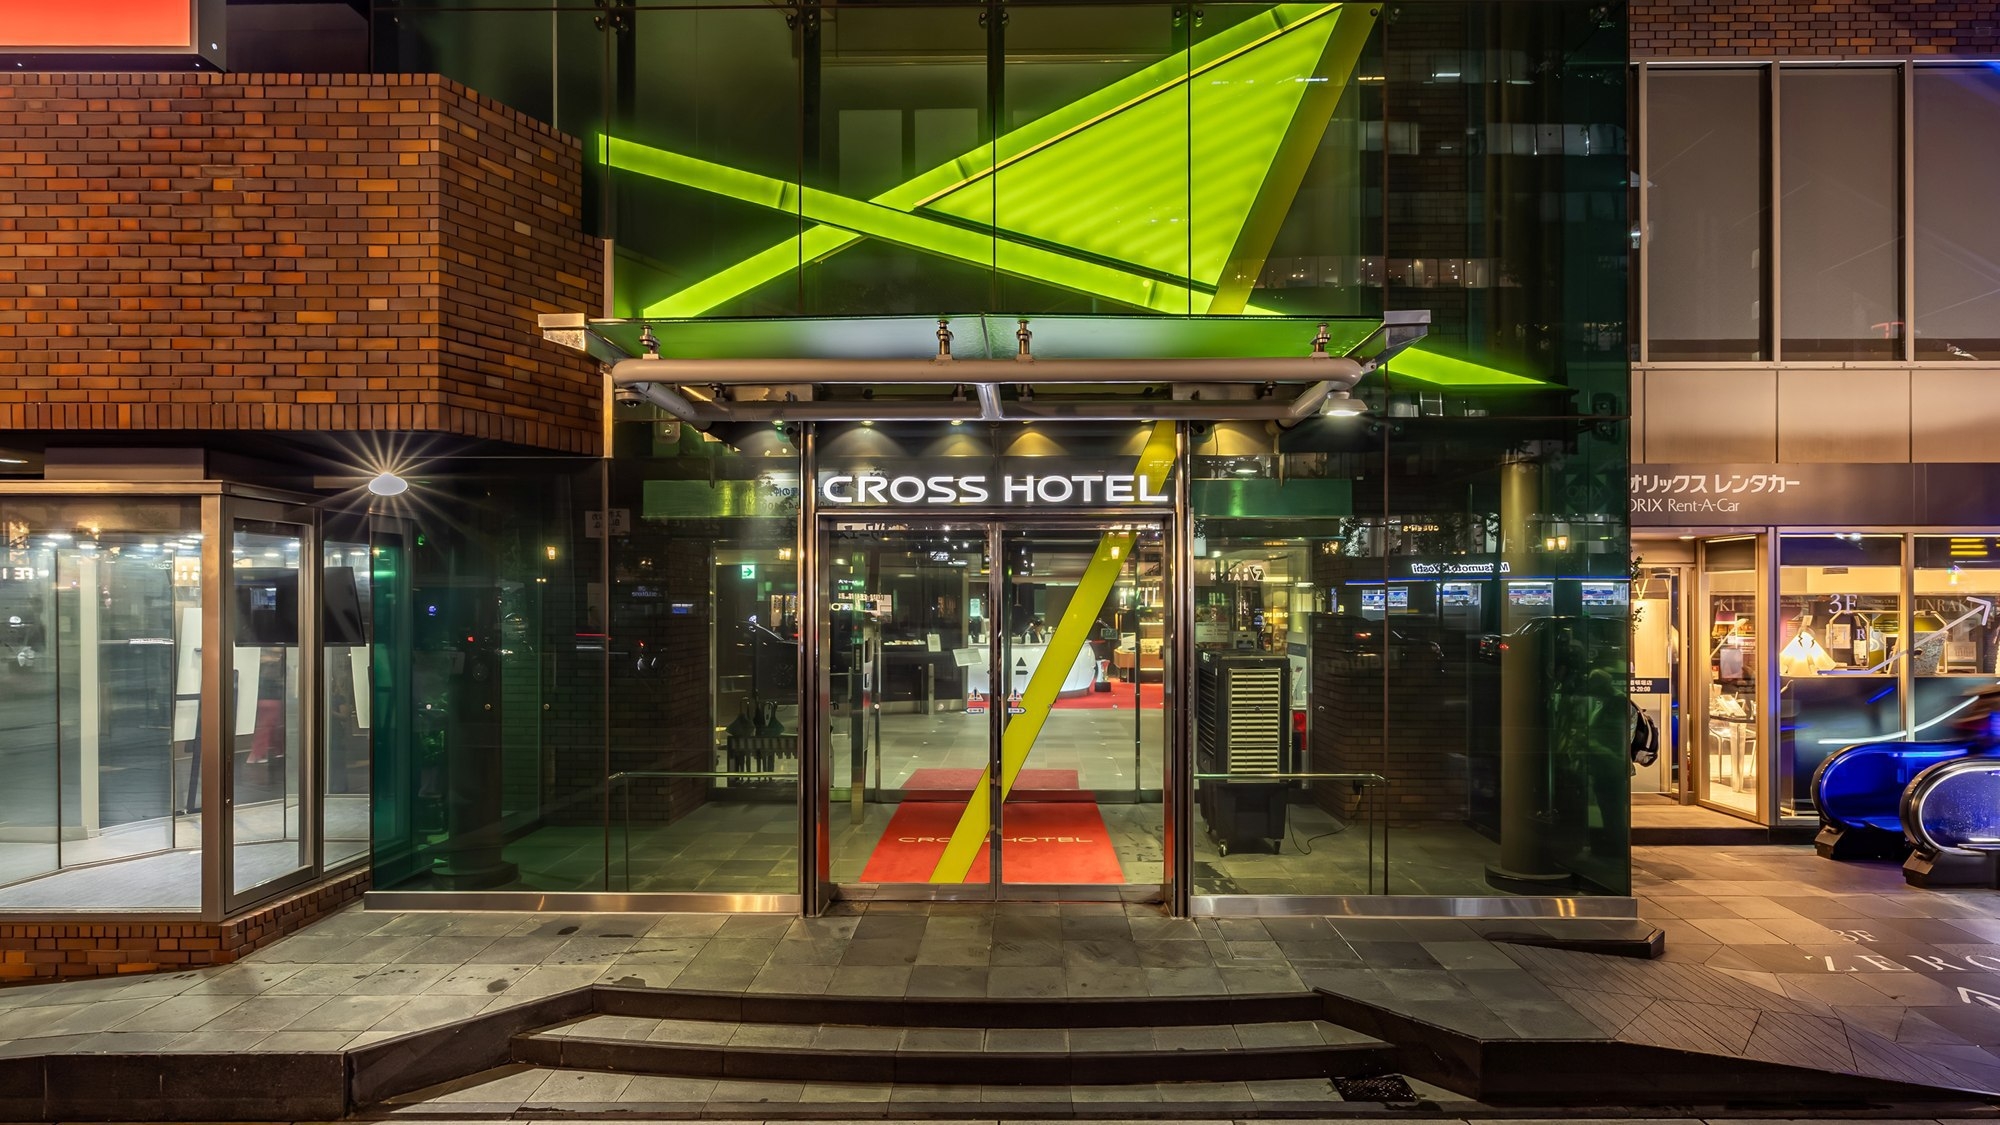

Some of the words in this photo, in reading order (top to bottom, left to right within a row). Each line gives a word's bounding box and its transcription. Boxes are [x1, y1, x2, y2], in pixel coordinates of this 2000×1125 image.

[822, 475, 989, 504] CROSS
[1004, 475, 1169, 503] HOTEL
[1714, 474, 1801, 494] レンタカー
[1667, 498, 1741, 513] Rent-A-Car
[1828, 593, 1858, 614] 3F
